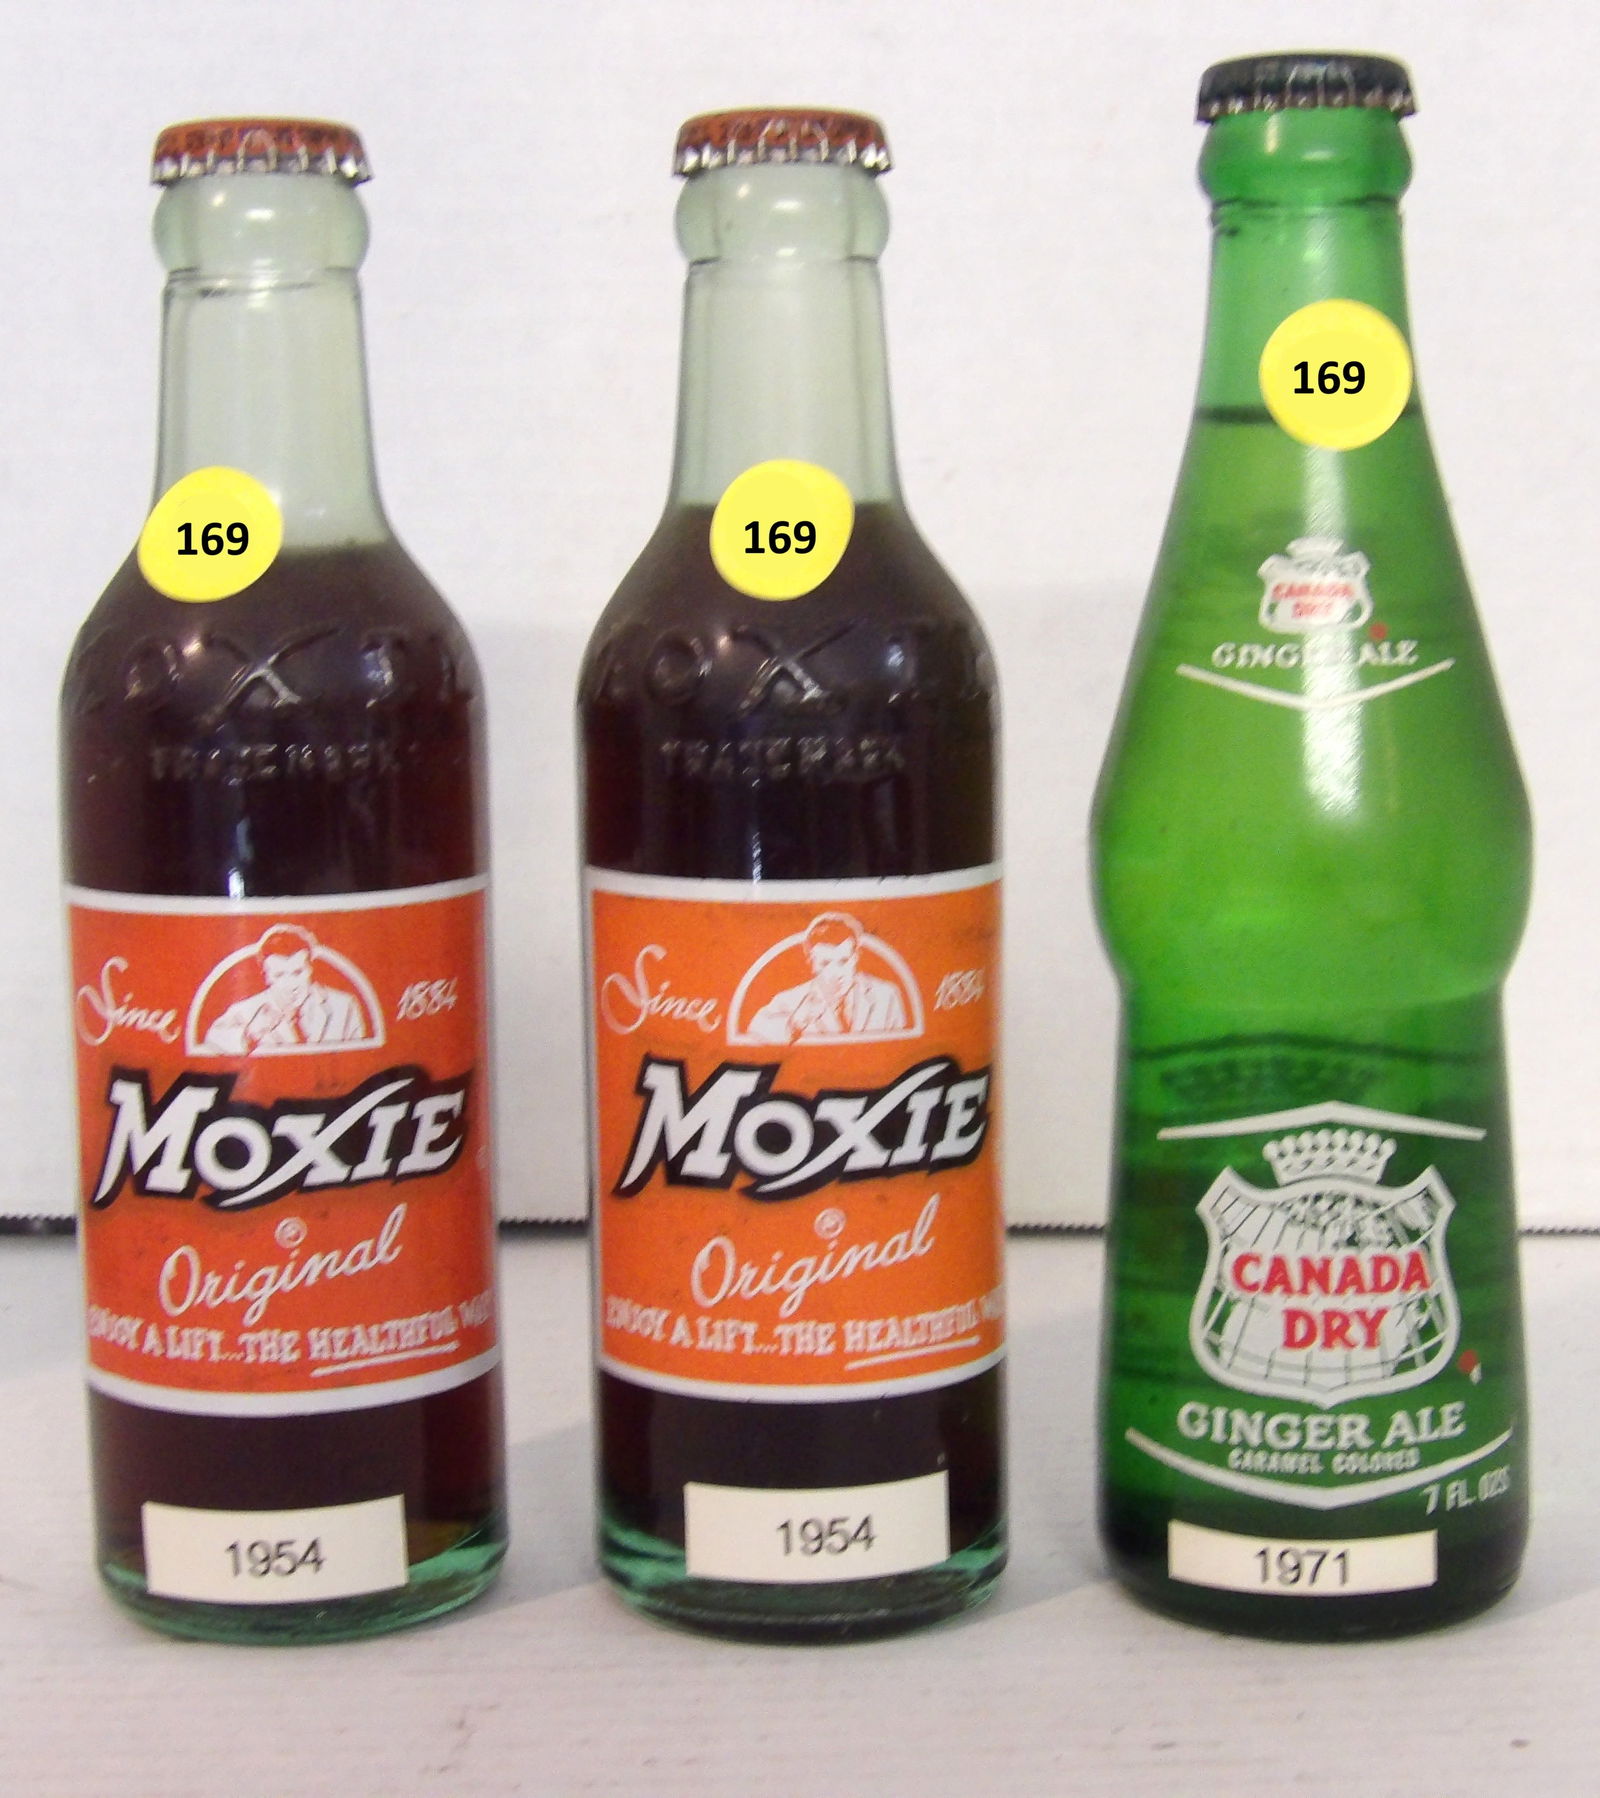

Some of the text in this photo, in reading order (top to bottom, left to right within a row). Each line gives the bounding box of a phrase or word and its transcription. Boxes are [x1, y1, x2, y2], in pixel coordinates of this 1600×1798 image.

[1357, 639, 1419, 667] ALE
[76, 956, 181, 1046] Since
[397, 977, 458, 1021] 1884
[601, 944, 721, 1035] Since
[159, 1203, 407, 1326] Original
[691, 1193, 940, 1319] Original
[1231, 1250, 1431, 1296] CANADA
[142, 1323, 165, 1357] A
[668, 1315, 693, 1348] A
[1282, 1307, 1389, 1350] DRY
[1177, 1400, 1467, 1450] GINGER ALE
[1228, 1447, 1421, 1475] CARAMEL COLORED
[1419, 1482, 1440, 1516] 7
[776, 1513, 878, 1556] 1954
[225, 1536, 326, 1578] 1954
[1254, 1547, 1351, 1587] 1971
